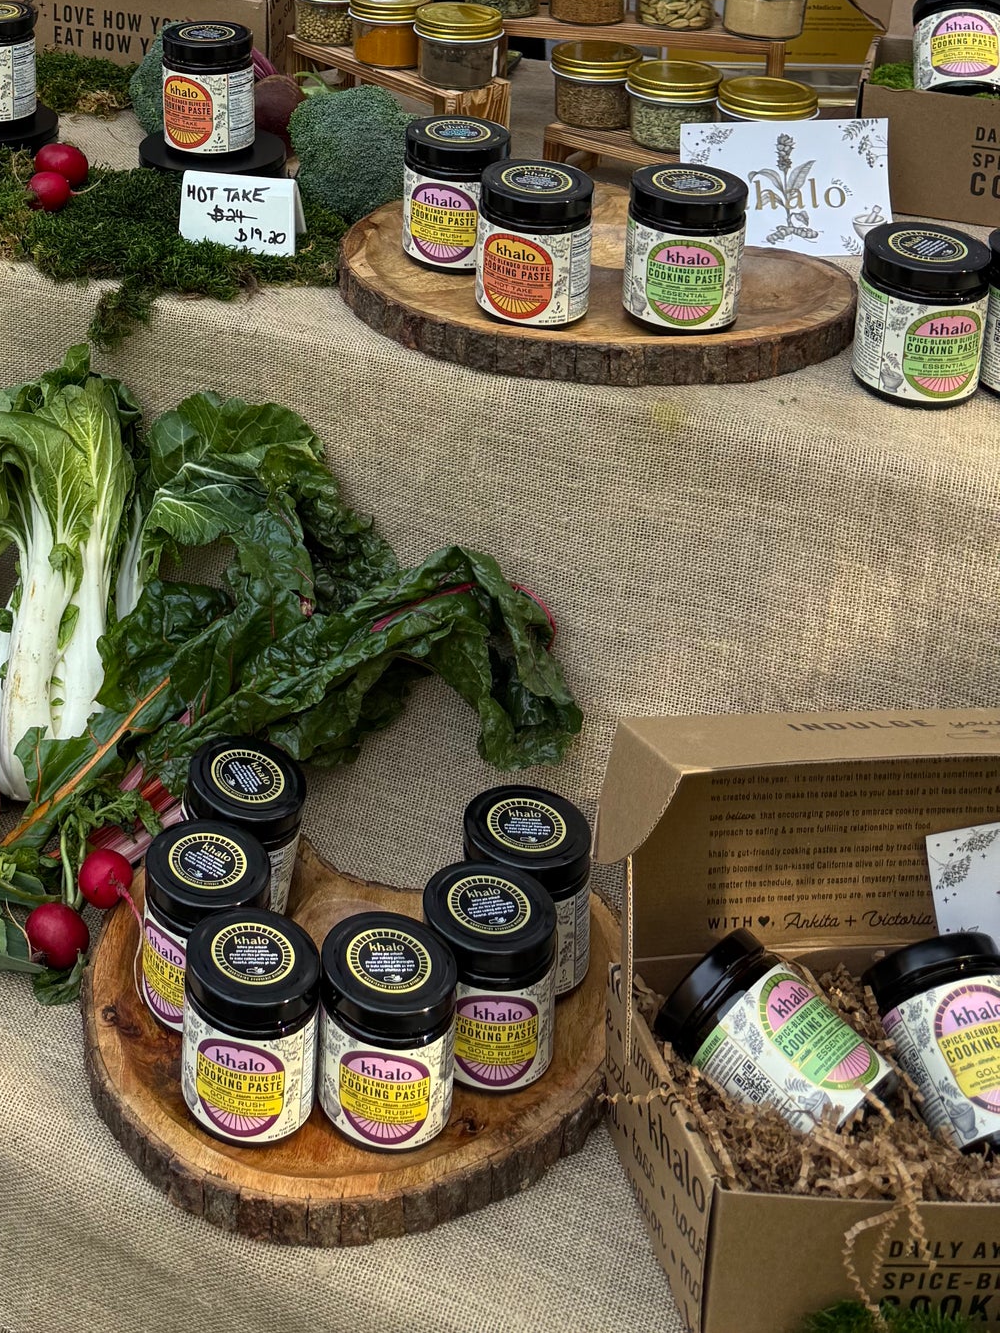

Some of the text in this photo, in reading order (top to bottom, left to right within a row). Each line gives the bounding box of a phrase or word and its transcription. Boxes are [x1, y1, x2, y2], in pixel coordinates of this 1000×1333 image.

[53, 3, 142, 32] LOVE HOW
[945, 19, 984, 33] khalo
[54, 26, 84, 47] EAT
[93, 33, 131, 54] HOW
[932, 38, 997, 49] COOKING PASTE
[170, 83, 198, 99] khalo
[188, 106, 211, 116] PASTE
[186, 184, 270, 203] HOT TAKE
[423, 191, 462, 208] khalo
[412, 207, 475, 227] COOKING PASTE
[235, 227, 287, 245] $19.20
[496, 243, 536, 262] khalo
[666, 249, 711, 266] khalo
[485, 259, 551, 281] COOKING PASTE
[648, 267, 723, 284] COOKING PASTE
[661, 289, 707, 299] ESSENTIAL
[929, 321, 972, 336] khalo
[906, 338, 979, 355] COOKING PASTE
[908, 335, 957, 346] SPICE-BLENDED
[922, 361, 967, 370] ESSENTIAL
[787, 719, 936, 732] INDULGE
[251, 761, 271, 785] khalo
[903, 770, 983, 780] intentions sometimes
[508, 807, 542, 818] khalo
[725, 806, 963, 821] believe encouraging embrace cooking empowers
[709, 824, 894, 838] approach fulfilling relationship
[202, 842, 231, 863] khalo
[737, 844, 884, 858] gut-friendly cooking pastes inspired
[817, 861, 853, 870] California
[862, 874, 896, 884] (mystery)
[467, 886, 501, 898] khalo
[707, 916, 752, 929] WITH
[783, 911, 840, 930] Ankita
[149, 929, 183, 965] khalo
[233, 936, 269, 945] khalo
[368, 942, 405, 952] khalo
[770, 985, 810, 1020] khalo
[473, 1004, 523, 1022] khalo
[507, 1025, 537, 1041] PASTE
[509, 1021, 526, 1031] OLIVE
[774, 1010, 811, 1046] SPICE-BLENDED
[782, 1016, 822, 1057] COOKING
[942, 1024, 998, 1049] SPICE-BLENDED
[467, 1046, 524, 1057] GOLD RUSH
[816, 1031, 850, 1060] ESSENTIAL
[199, 1054, 247, 1082] SPICE-BLENDED
[271, 1074, 281, 1082] OIL
[215, 1048, 265, 1072] khalo
[198, 1061, 282, 1092] COOKING PASTE
[342, 1067, 427, 1091] SPICE-BLENDED OLIVE OIL
[360, 1060, 412, 1081] khalo
[341, 1073, 428, 1101] COOKING PASTE
[210, 1089, 265, 1108] GOLD RUSH
[354, 1100, 413, 1116] GOLD RUSH
[647, 1109, 705, 1213] khalo
